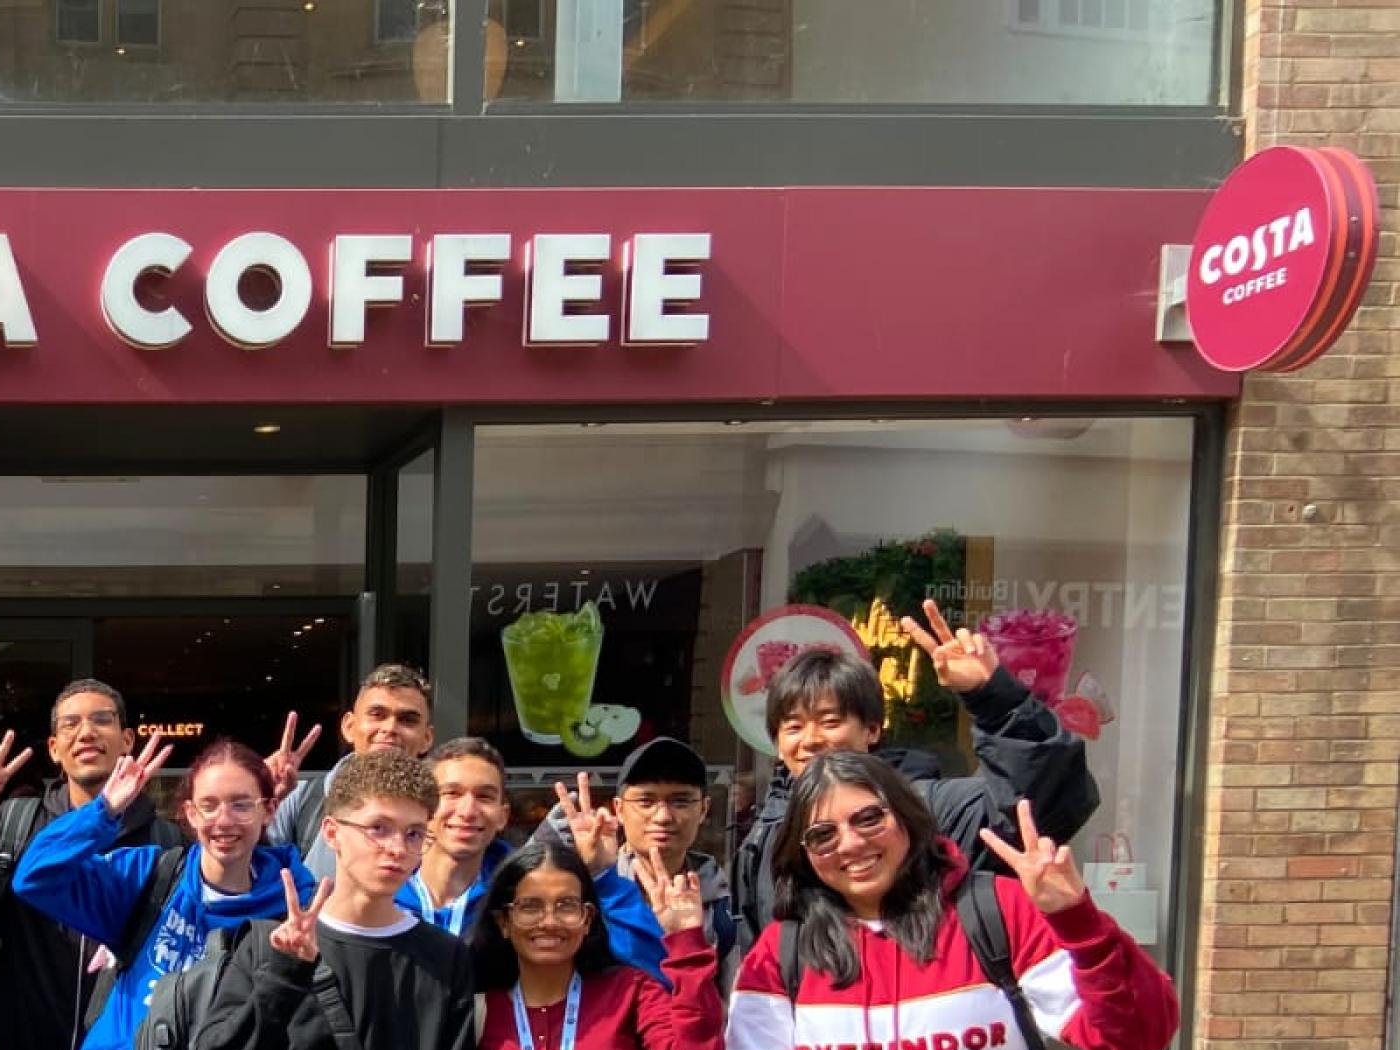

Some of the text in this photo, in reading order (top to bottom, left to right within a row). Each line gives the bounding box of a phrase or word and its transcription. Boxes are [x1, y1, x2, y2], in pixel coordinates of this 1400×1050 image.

[1200, 207, 1315, 284] COSTA
[99, 231, 711, 350] COFFEE
[1222, 267, 1288, 304] COFFEE
[138, 723, 204, 736] COLLECT
